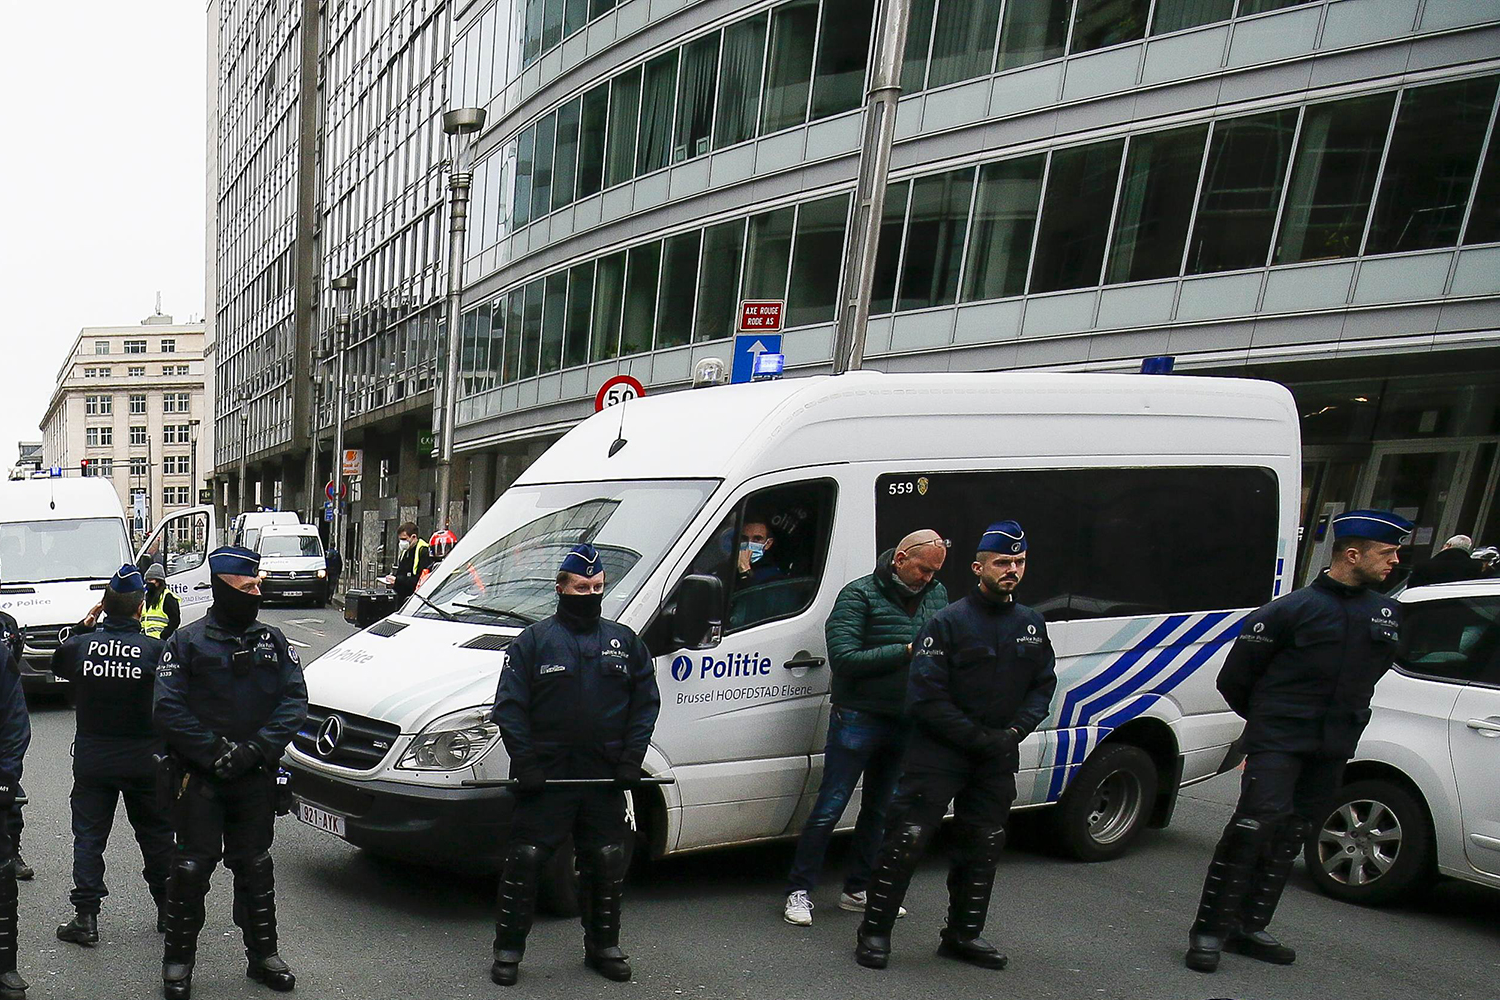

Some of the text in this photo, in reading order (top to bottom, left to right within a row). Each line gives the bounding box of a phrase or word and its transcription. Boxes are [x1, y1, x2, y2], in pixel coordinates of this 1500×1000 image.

[747, 318, 763, 326] RODE
[607, 390, 634, 406] 50
[888, 482, 914, 495] 559
[16, 598, 51, 606] Police
[88, 639, 142, 658] Police
[339, 649, 374, 664] Police
[83, 660, 142, 679] Politie
[700, 652, 772, 679] Politie
[676, 684, 812, 704] Brussel HOOFDSTAD Elsene
[303, 805, 340, 832] 921-AYK
